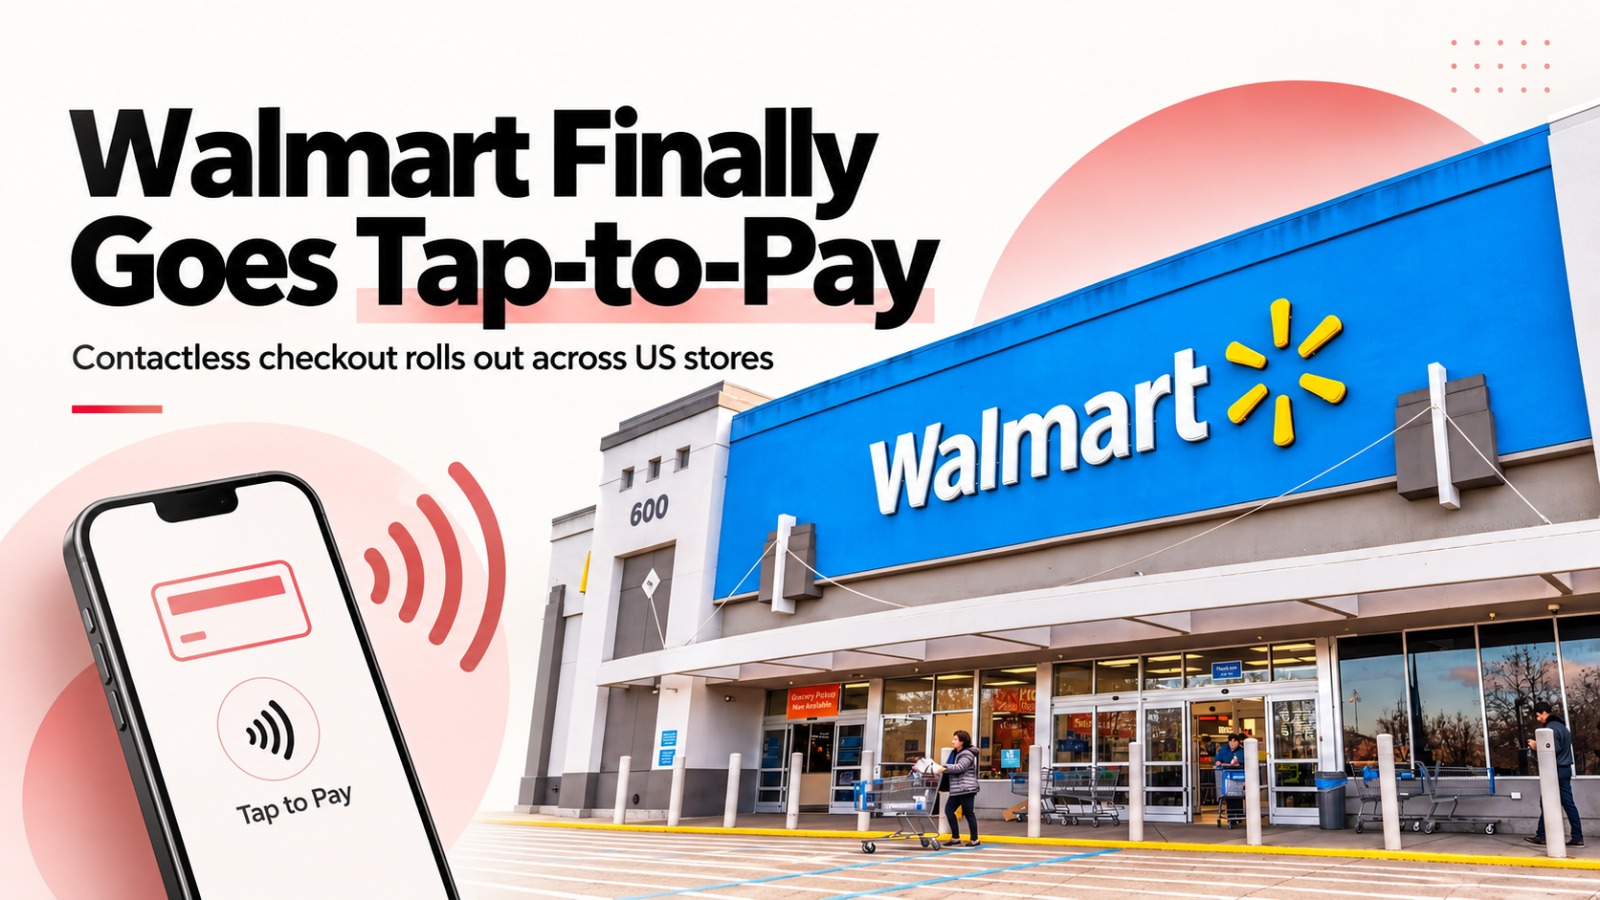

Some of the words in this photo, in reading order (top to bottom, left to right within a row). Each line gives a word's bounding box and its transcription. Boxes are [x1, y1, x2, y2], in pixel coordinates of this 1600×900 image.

[869, 347, 1210, 516] Walmart
[630, 493, 669, 527] 600
[236, 804, 280, 825] Tap
[282, 796, 308, 815] to
[311, 785, 351, 807] Pay
